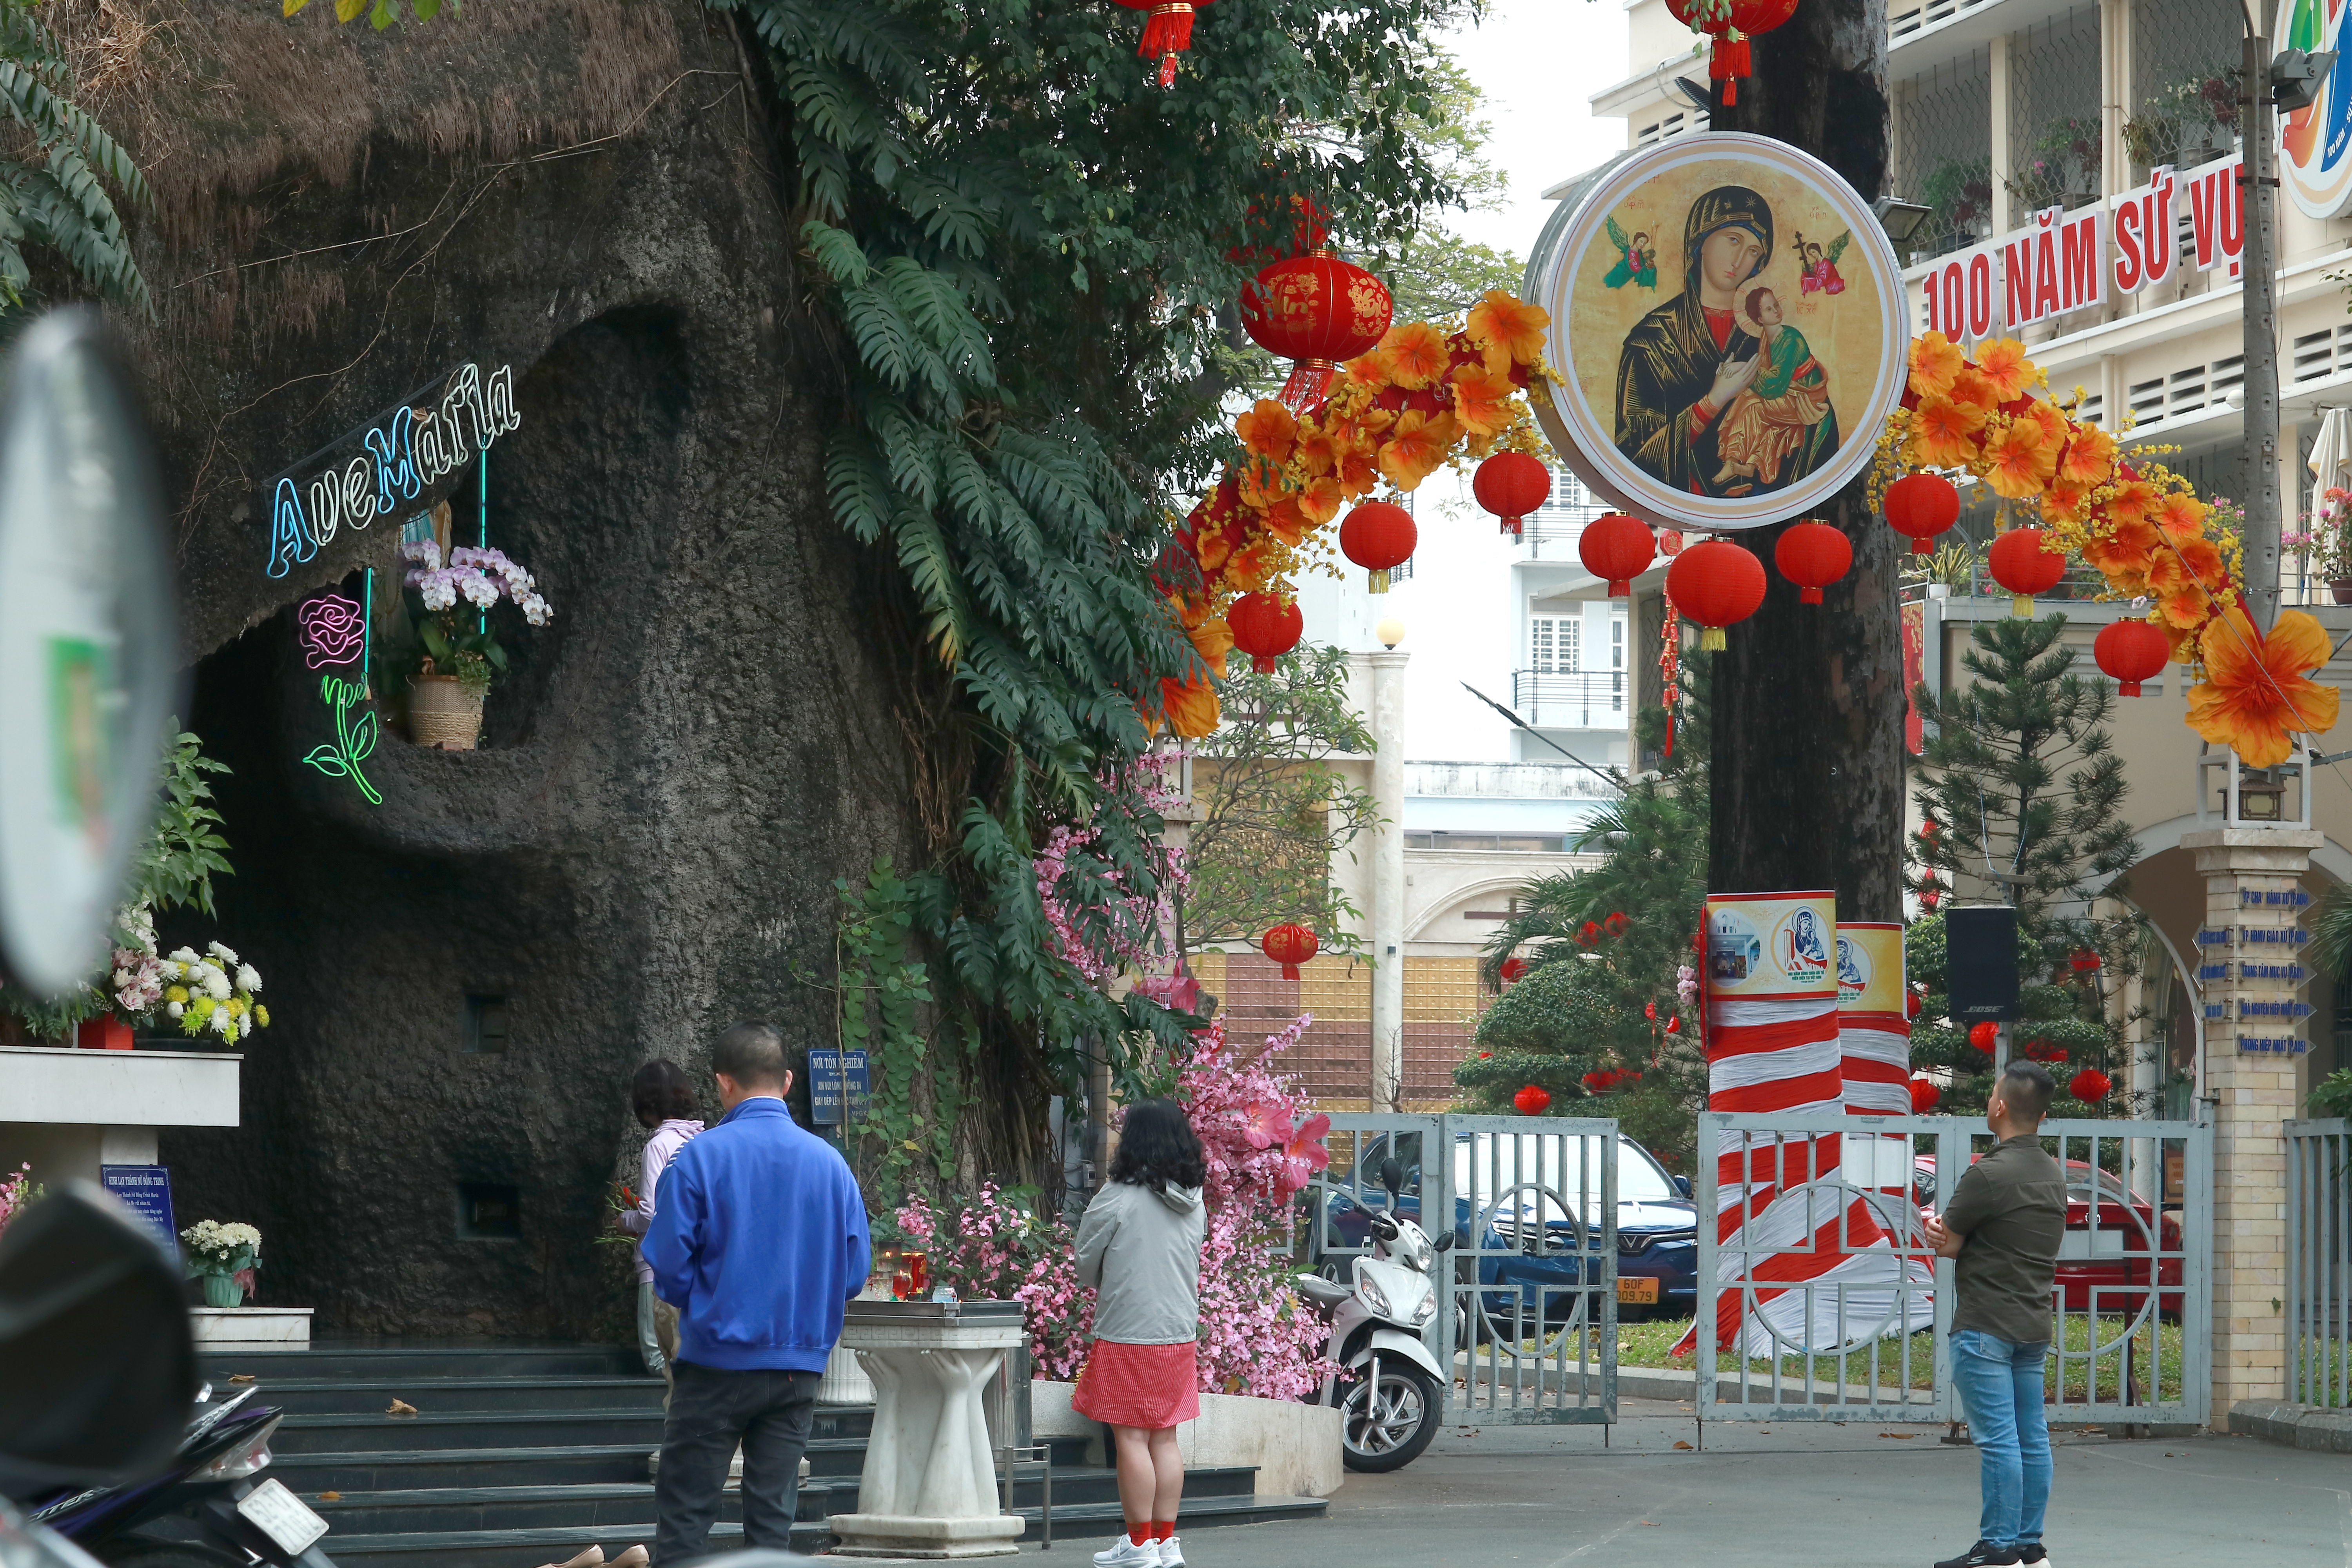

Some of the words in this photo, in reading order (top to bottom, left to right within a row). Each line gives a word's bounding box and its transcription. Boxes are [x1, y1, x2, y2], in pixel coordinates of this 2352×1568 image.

[1924, 253, 1990, 343] 100
[2005, 211, 2097, 327] NĂM
[2115, 168, 2174, 290] SỨ
[2190, 163, 2244, 277] VỤ
[2243, 891, 2250, 903] VP
[2282, 890, 2290, 905] XỨ
[2243, 930, 2249, 941] VP
[2250, 930, 2265, 942] HĐMV
[2267, 927, 2279, 942] GIÁO
[2280, 927, 2288, 943] XỨ
[2242, 965, 2257, 978] TRUNG
[2258, 963, 2269, 978] TÂM
[2269, 966, 2280, 981] MỤC
[2281, 966, 2287, 981] VỤ
[2241, 999, 2250, 1015] NHÀ
[2252, 1000, 2269, 1018] NGUYỆN
[2270, 1000, 2280, 1018] HIỆP
[2241, 1035, 2258, 1051] PHÒNG
[2260, 1036, 2272, 1054] HIỆP
[2274, 1035, 2287, 1052] NHẤT
[813, 1056, 824, 1069] NƠI
[824, 1054, 837, 1069] TÔN
[838, 1054, 864, 1069] NGHIÊM
[832, 1079, 842, 1091] LÒNG
[843, 1079, 857, 1091] HÔNG
[857, 1081, 862, 1090] ĐI
[815, 1094, 823, 1106] GIÀY
[125, 1174, 138, 1185] THÁNH
[143, 1172, 153, 1186] ĐỒNG
[153, 1177, 165, 1186] TRINH
[1624, 1279, 1644, 1289] 60F
